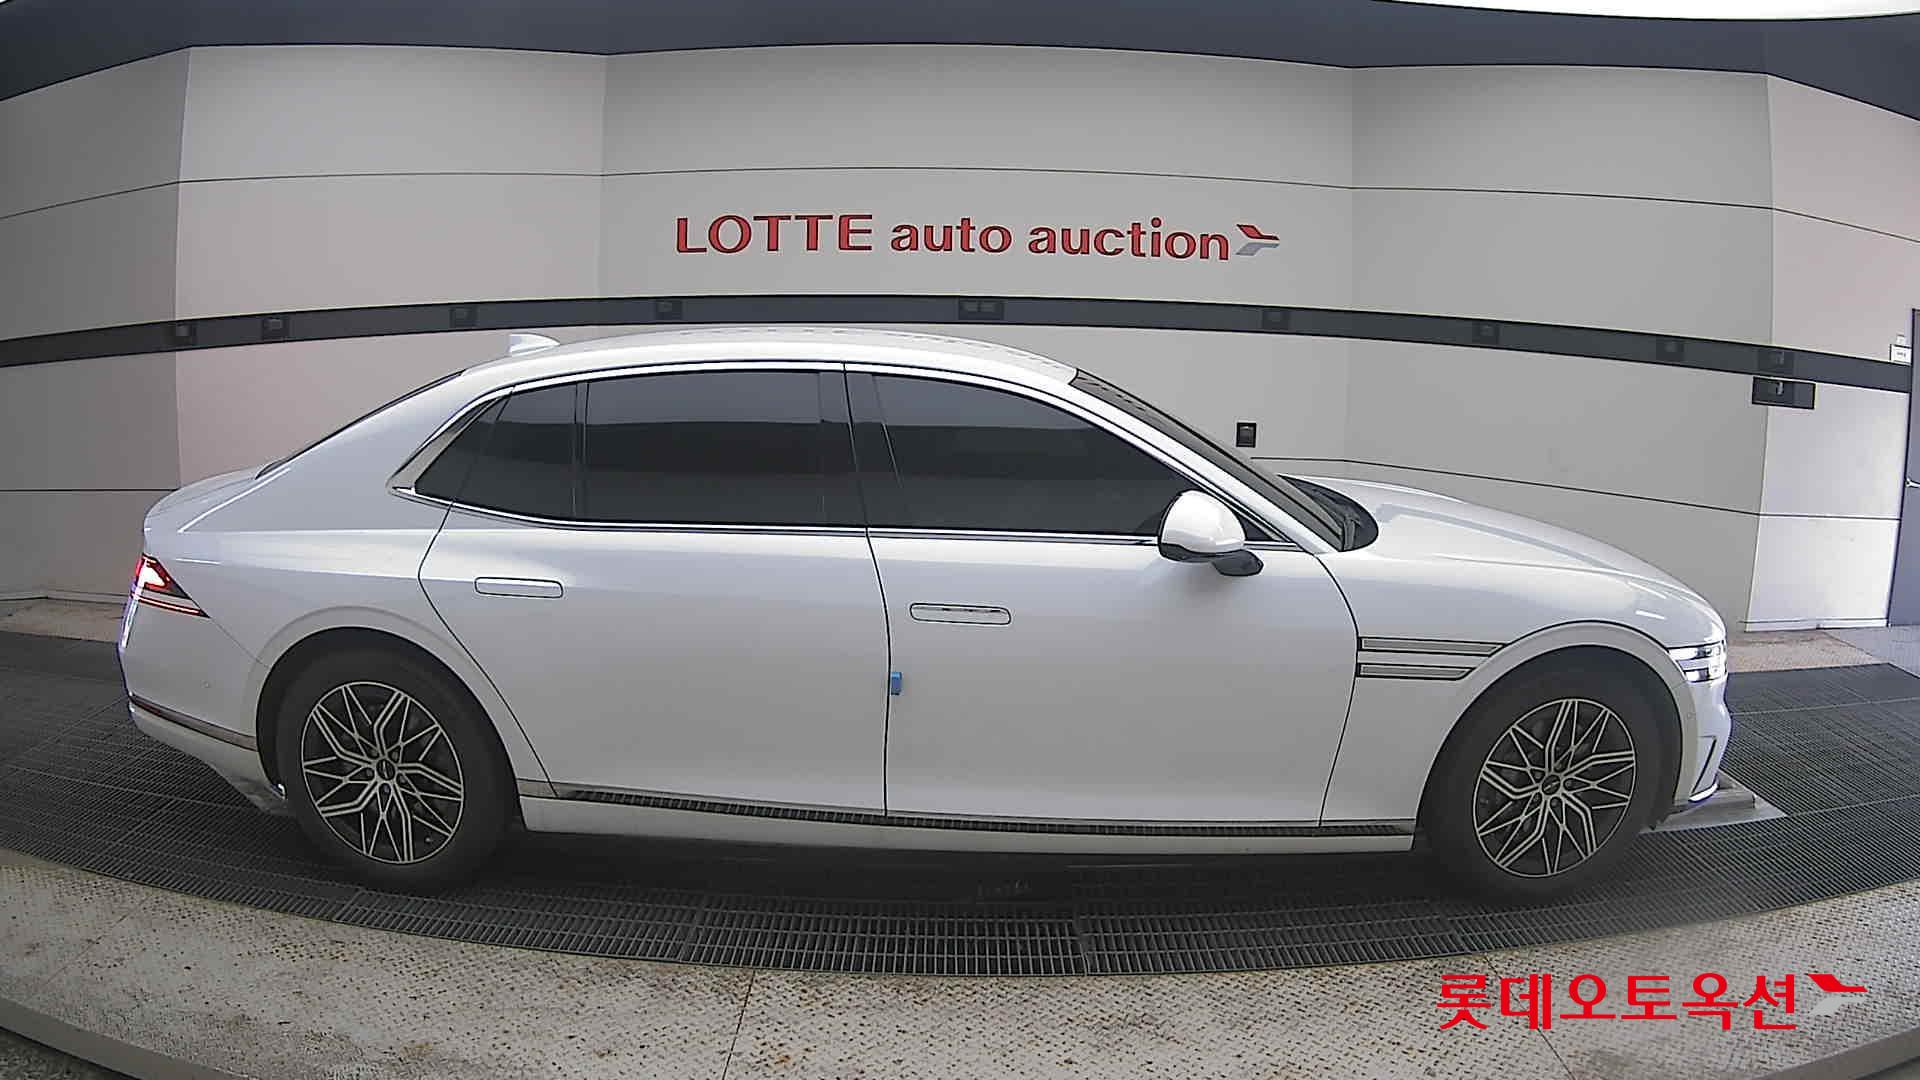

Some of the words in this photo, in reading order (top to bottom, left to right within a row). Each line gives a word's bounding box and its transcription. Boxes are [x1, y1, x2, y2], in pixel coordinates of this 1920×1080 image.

[676, 214, 873, 254] LOTTE
[890, 217, 1013, 254] auto
[1028, 218, 1230, 261] auction
